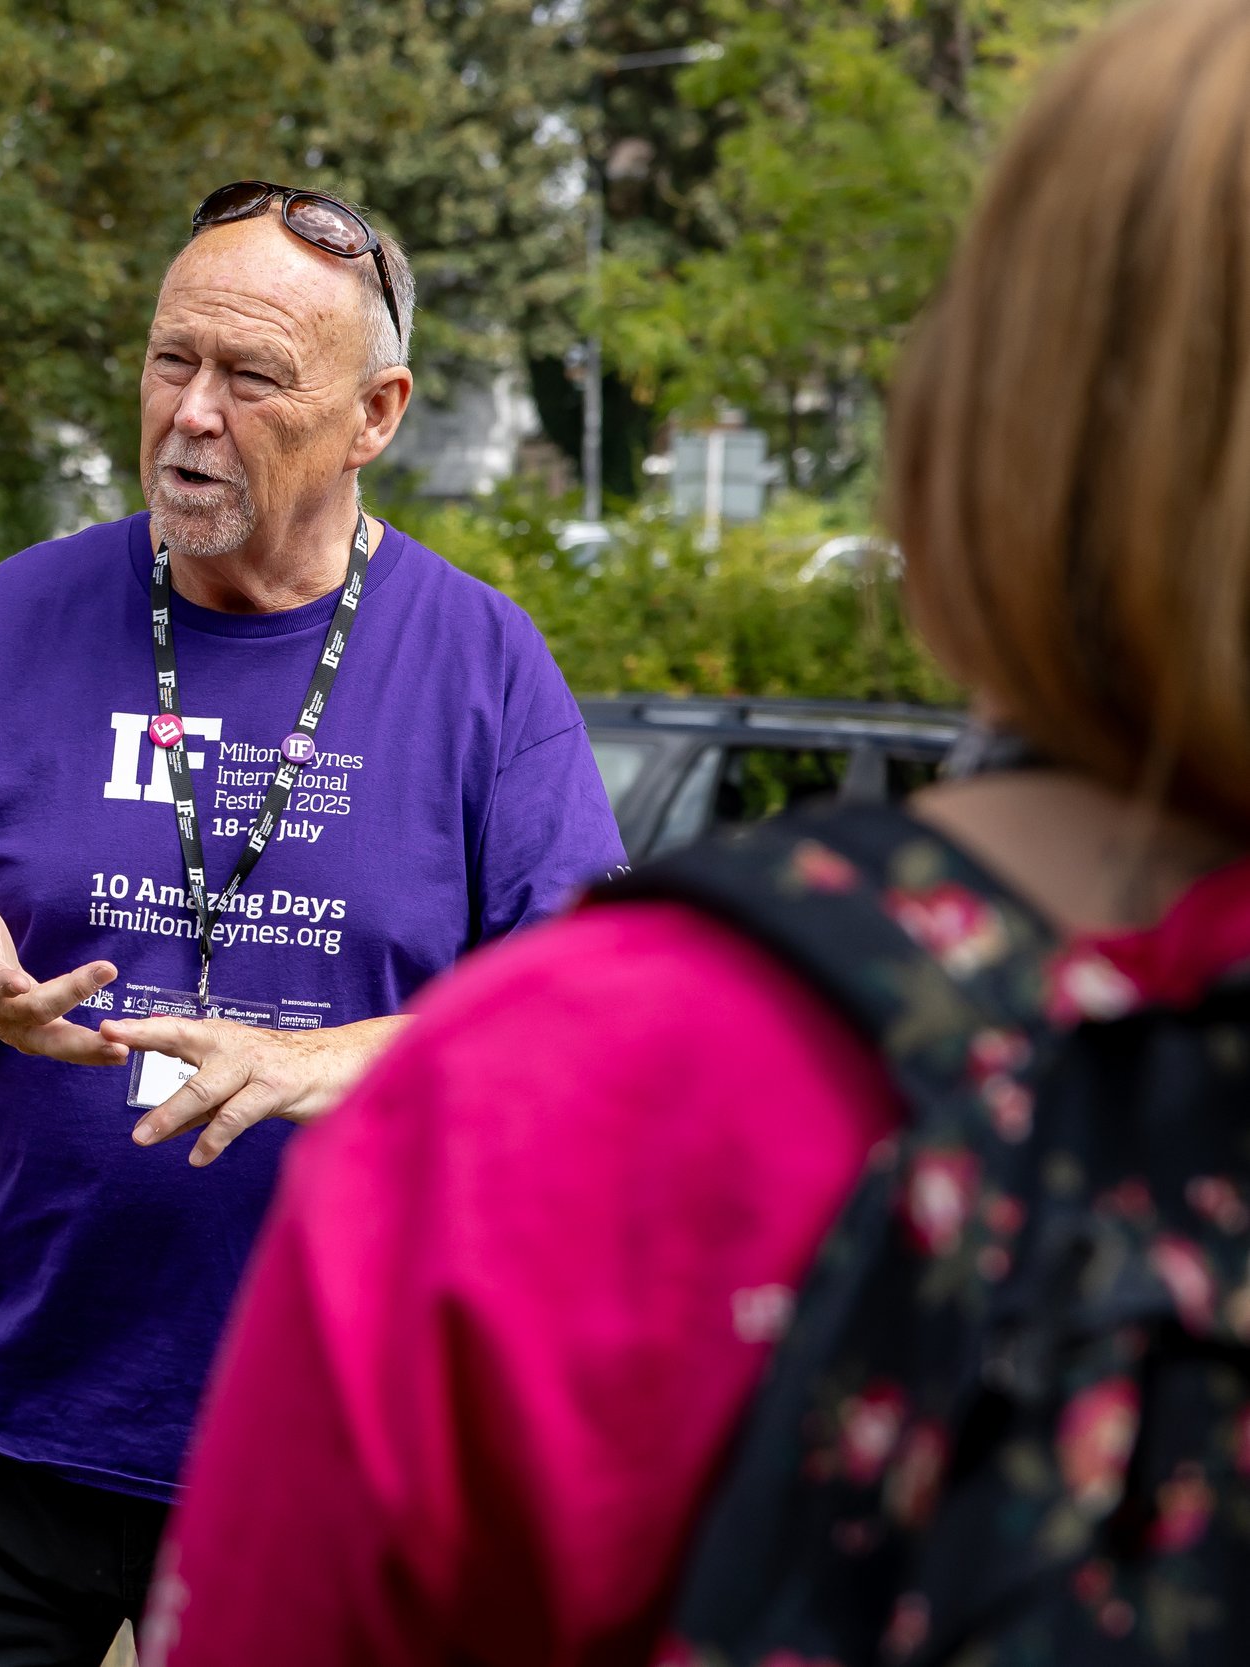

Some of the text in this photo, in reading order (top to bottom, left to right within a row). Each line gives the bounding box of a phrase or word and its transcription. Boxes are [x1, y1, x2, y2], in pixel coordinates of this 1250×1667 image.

[342, 588, 359, 611] IF
[153, 608, 168, 625] IF
[321, 647, 340, 669] IF
[158, 670, 176, 688] IF
[299, 708, 319, 730] IF
[153, 721, 181, 744] IF
[103, 712, 223, 805] IF
[219, 741, 282, 763] Milton
[288, 739, 311, 758] IF
[216, 765, 348, 791] Internional
[275, 767, 295, 790] IF
[176, 799, 195, 818] IF
[214, 789, 351, 815] Festil 2025
[248, 829, 266, 853] IF
[276, 819, 324, 843] July
[188, 867, 205, 886] IF
[90, 872, 129, 898] 10
[135, 878, 264, 919] Amazng
[270, 889, 346, 923] Days
[126, 982, 153, 992] Supported
[152, 1004, 170, 1012] ARTS
[171, 1006, 198, 1015] COUNCIL
[246, 1011, 271, 1019] Keynes
